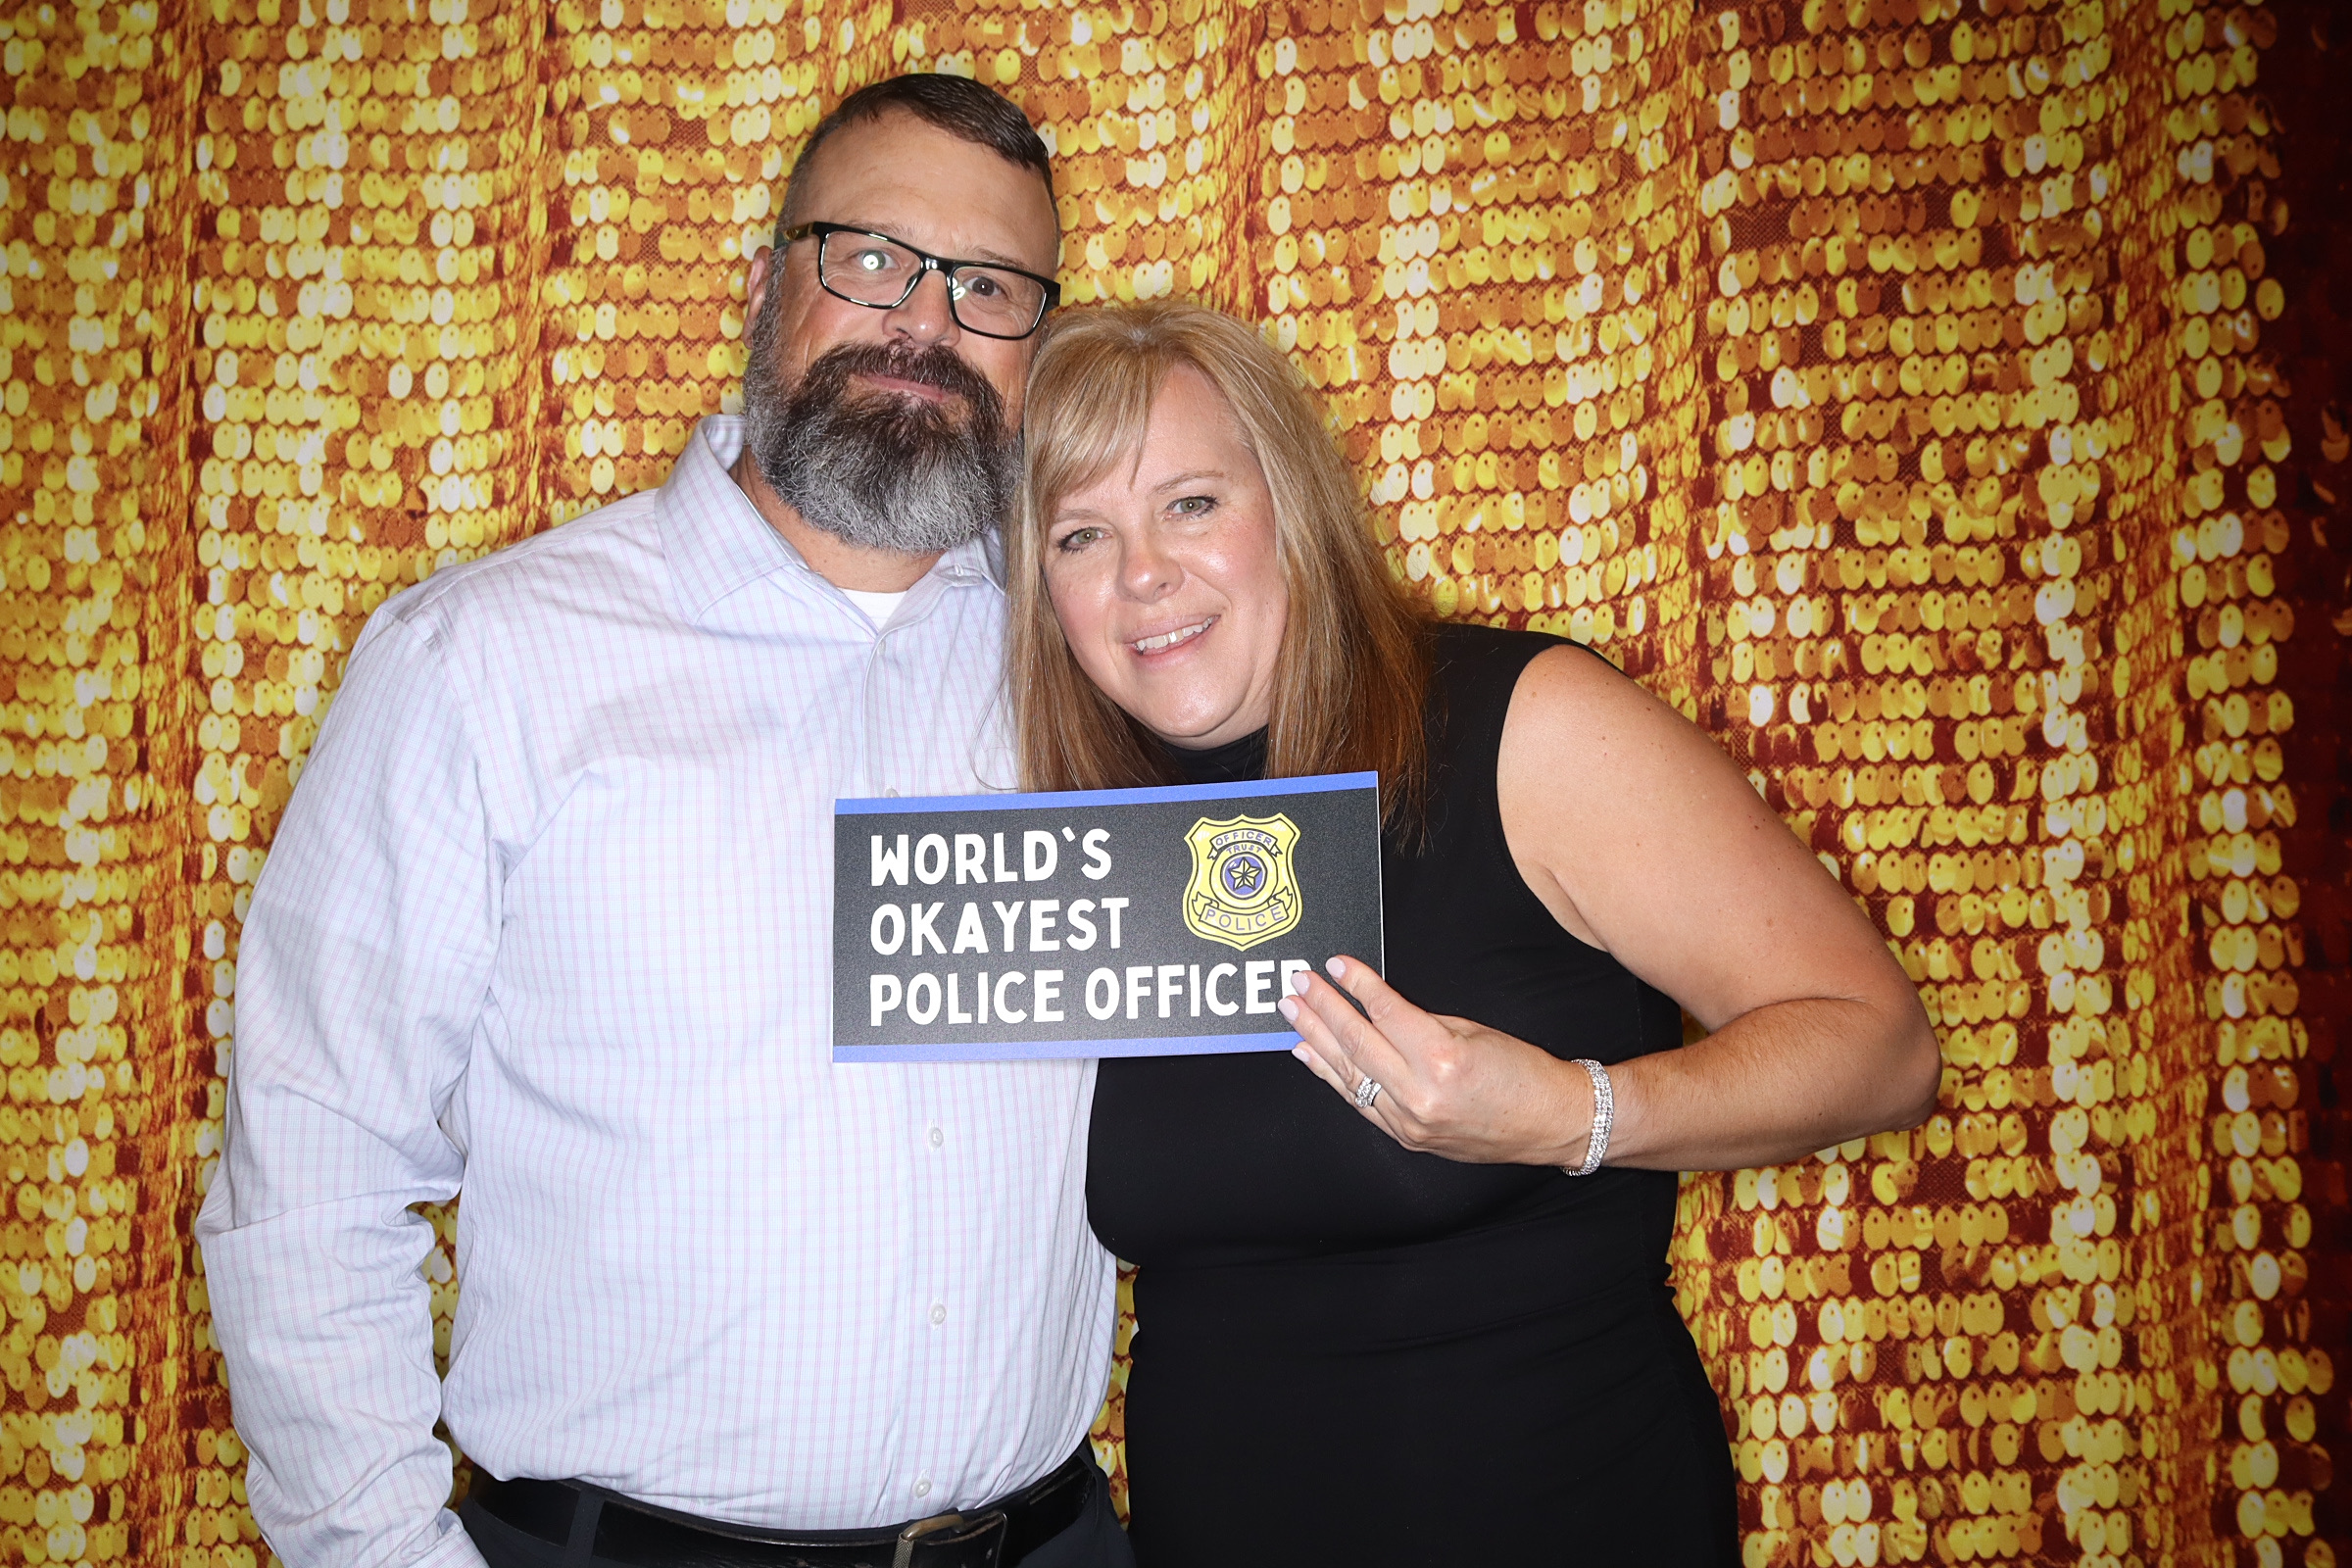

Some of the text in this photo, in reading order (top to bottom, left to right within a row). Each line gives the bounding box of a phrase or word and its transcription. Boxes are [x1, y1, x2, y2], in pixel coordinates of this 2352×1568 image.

[1215, 830, 1272, 847] OFFICER
[1226, 843, 1262, 855] TRUST
[870, 898, 1130, 956] OKAYEST
[1204, 906, 1284, 930] POLICE
[870, 966, 1064, 1027] POLICE
